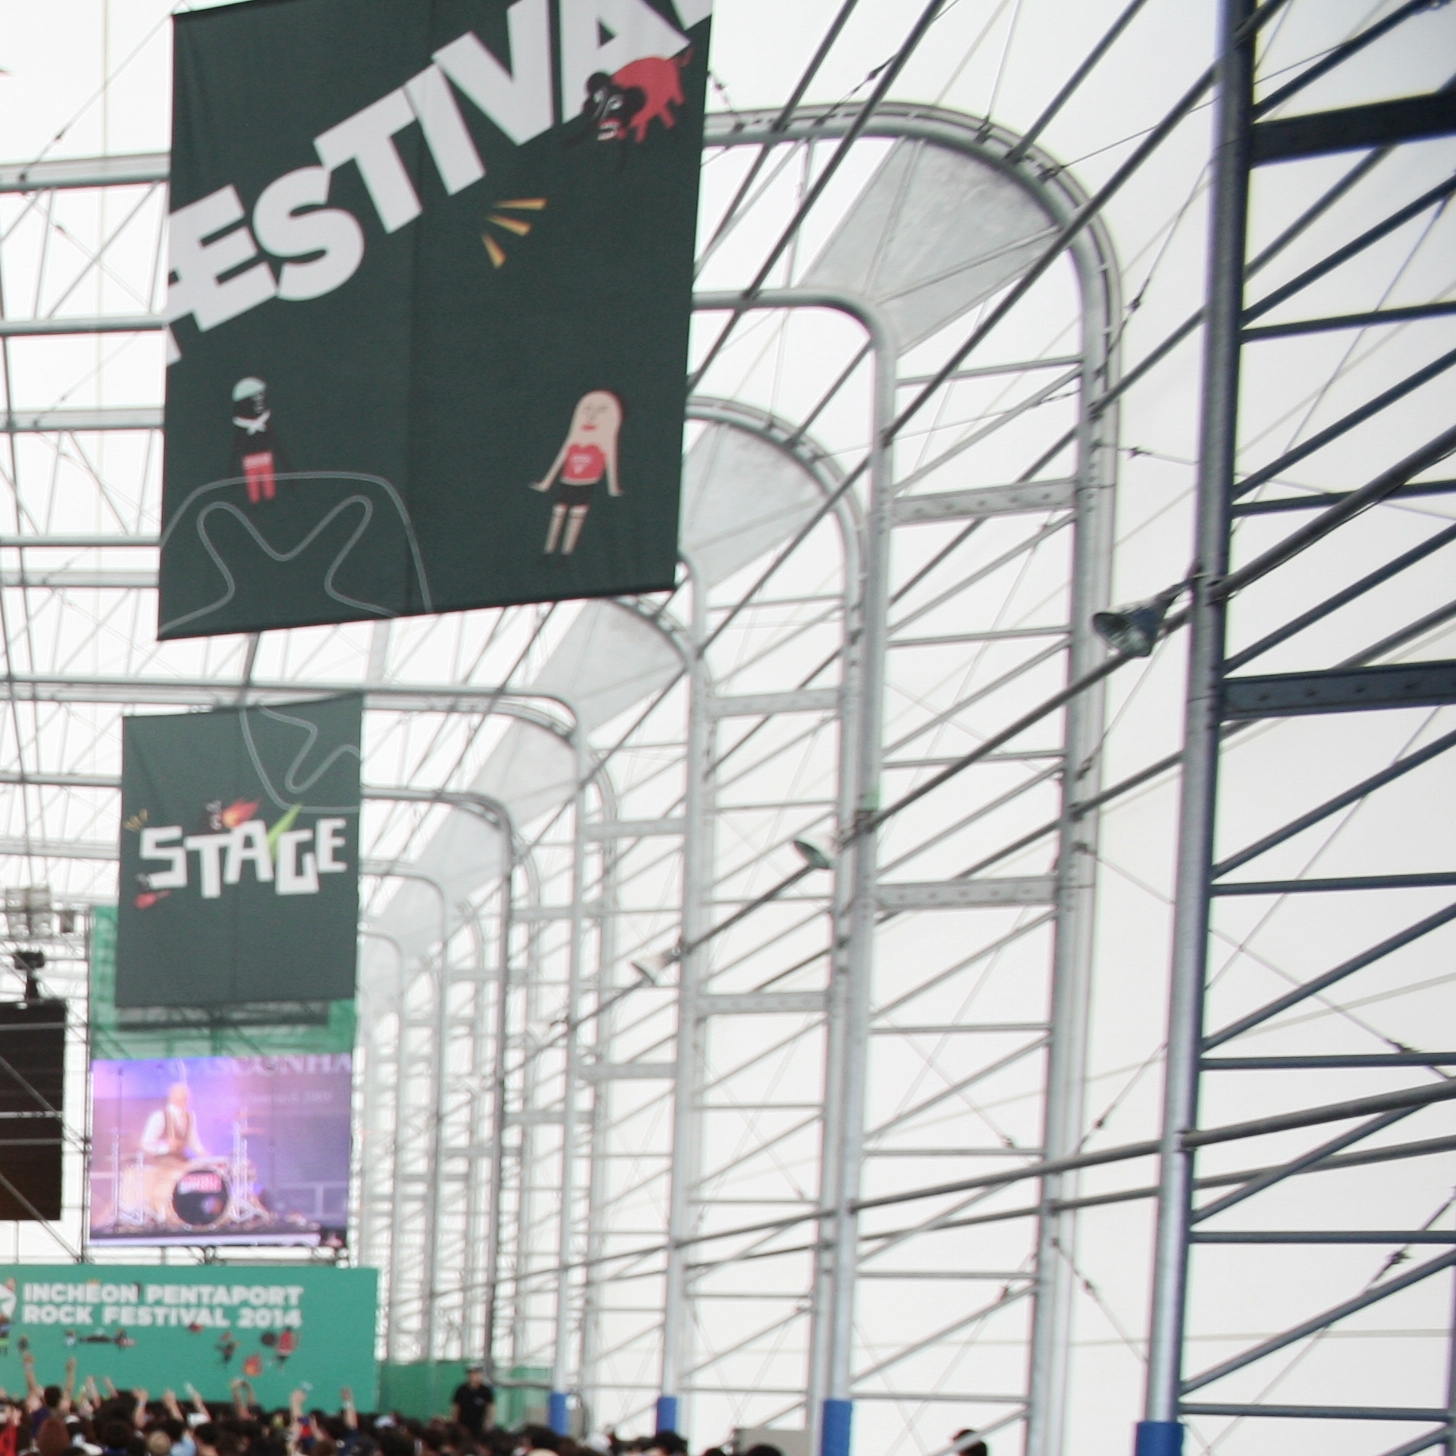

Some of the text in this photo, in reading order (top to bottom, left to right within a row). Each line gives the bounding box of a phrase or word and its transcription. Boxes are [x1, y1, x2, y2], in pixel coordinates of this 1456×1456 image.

[140, 818, 347, 898] STAGE
[23, 1283, 304, 1306] INCHEON PENTAPORT
[23, 1305, 303, 1328] ROCK FESTIVAL 2014
